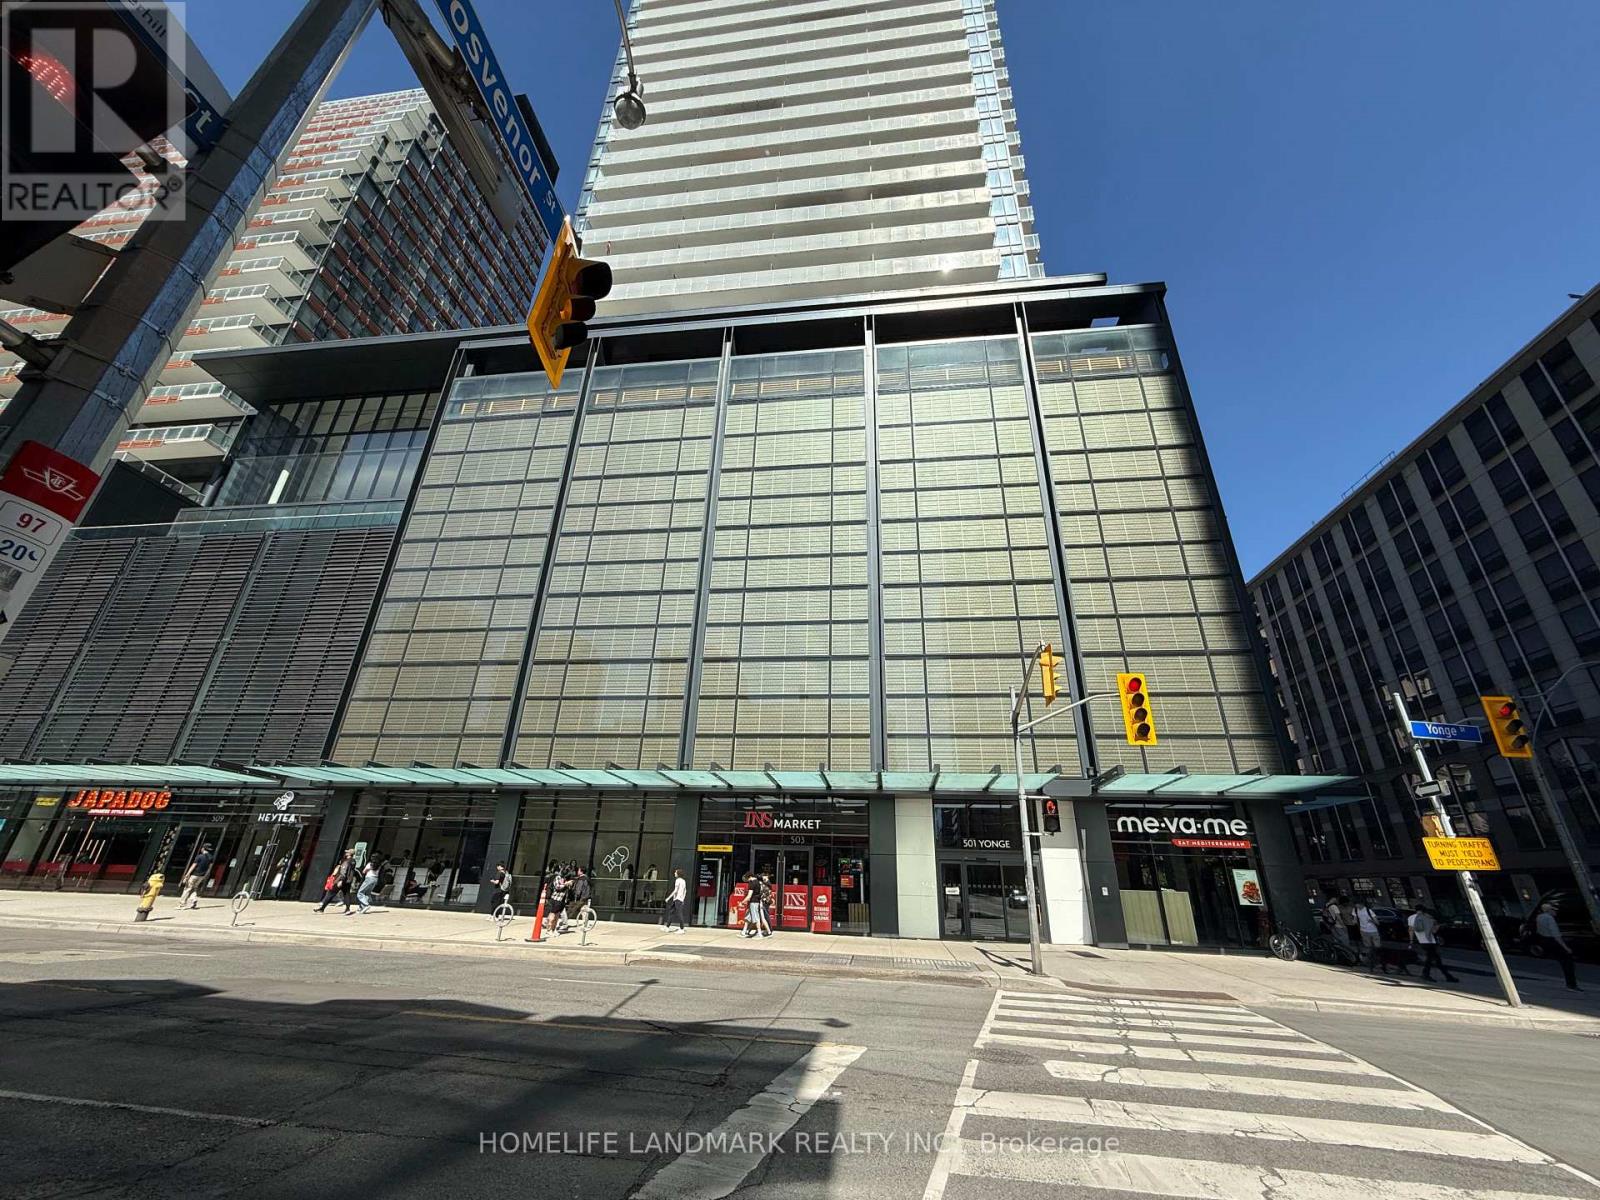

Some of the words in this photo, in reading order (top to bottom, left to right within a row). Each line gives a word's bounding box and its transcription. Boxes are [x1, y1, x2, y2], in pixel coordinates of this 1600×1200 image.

[544, 190, 556, 214] St
[16, 512, 47, 533] 97
[1425, 723, 1457, 737] Yonge
[66, 789, 172, 809] JAPADOG
[258, 813, 296, 822] HEYTEA
[744, 811, 773, 828] INS
[773, 819, 821, 829] MARKET
[790, 836, 805, 844] 503
[963, 839, 977, 848] 501
[978, 839, 1011, 848] YONGE
[1427, 841, 1457, 849] TURNING
[1459, 841, 1489, 849] TRAFFIC
[1439, 849, 1458, 857] MUST
[1462, 849, 1483, 857] YIELD
[1433, 858, 1445, 866] TO
[1447, 858, 1496, 867] PEDESTRIANS
[785, 893, 806, 906] INS
